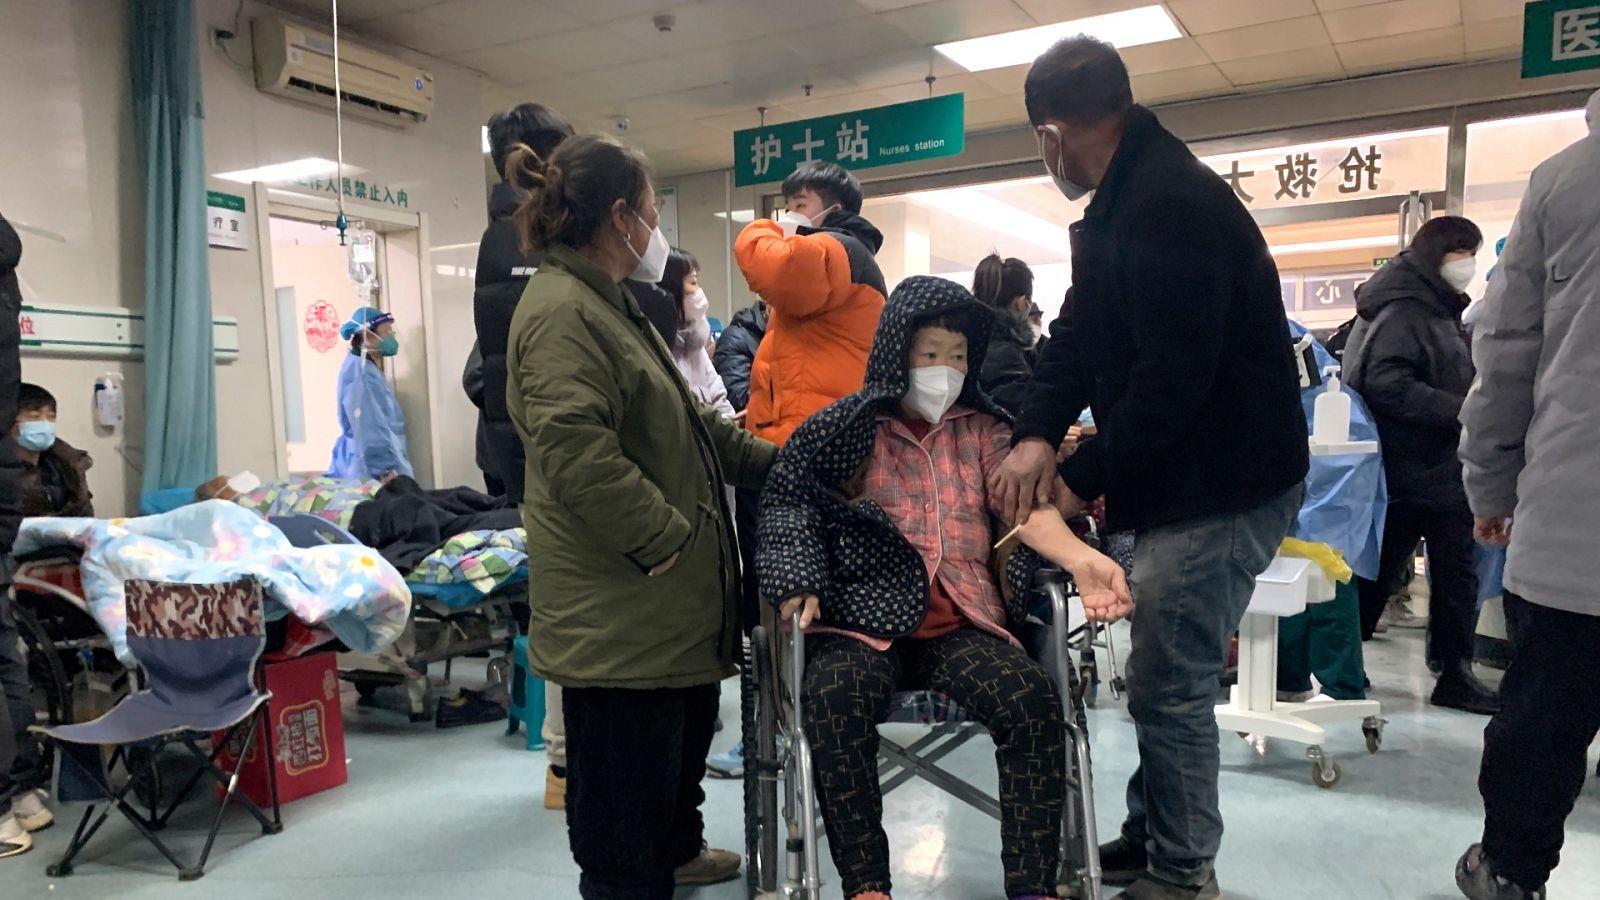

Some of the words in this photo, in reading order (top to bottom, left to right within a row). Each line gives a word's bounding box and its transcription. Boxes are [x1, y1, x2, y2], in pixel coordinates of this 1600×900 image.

[1552, 6, 1600, 61] 医
[751, 119, 870, 175] 护士站
[879, 143, 910, 156] Nurses
[914, 138, 945, 151] station
